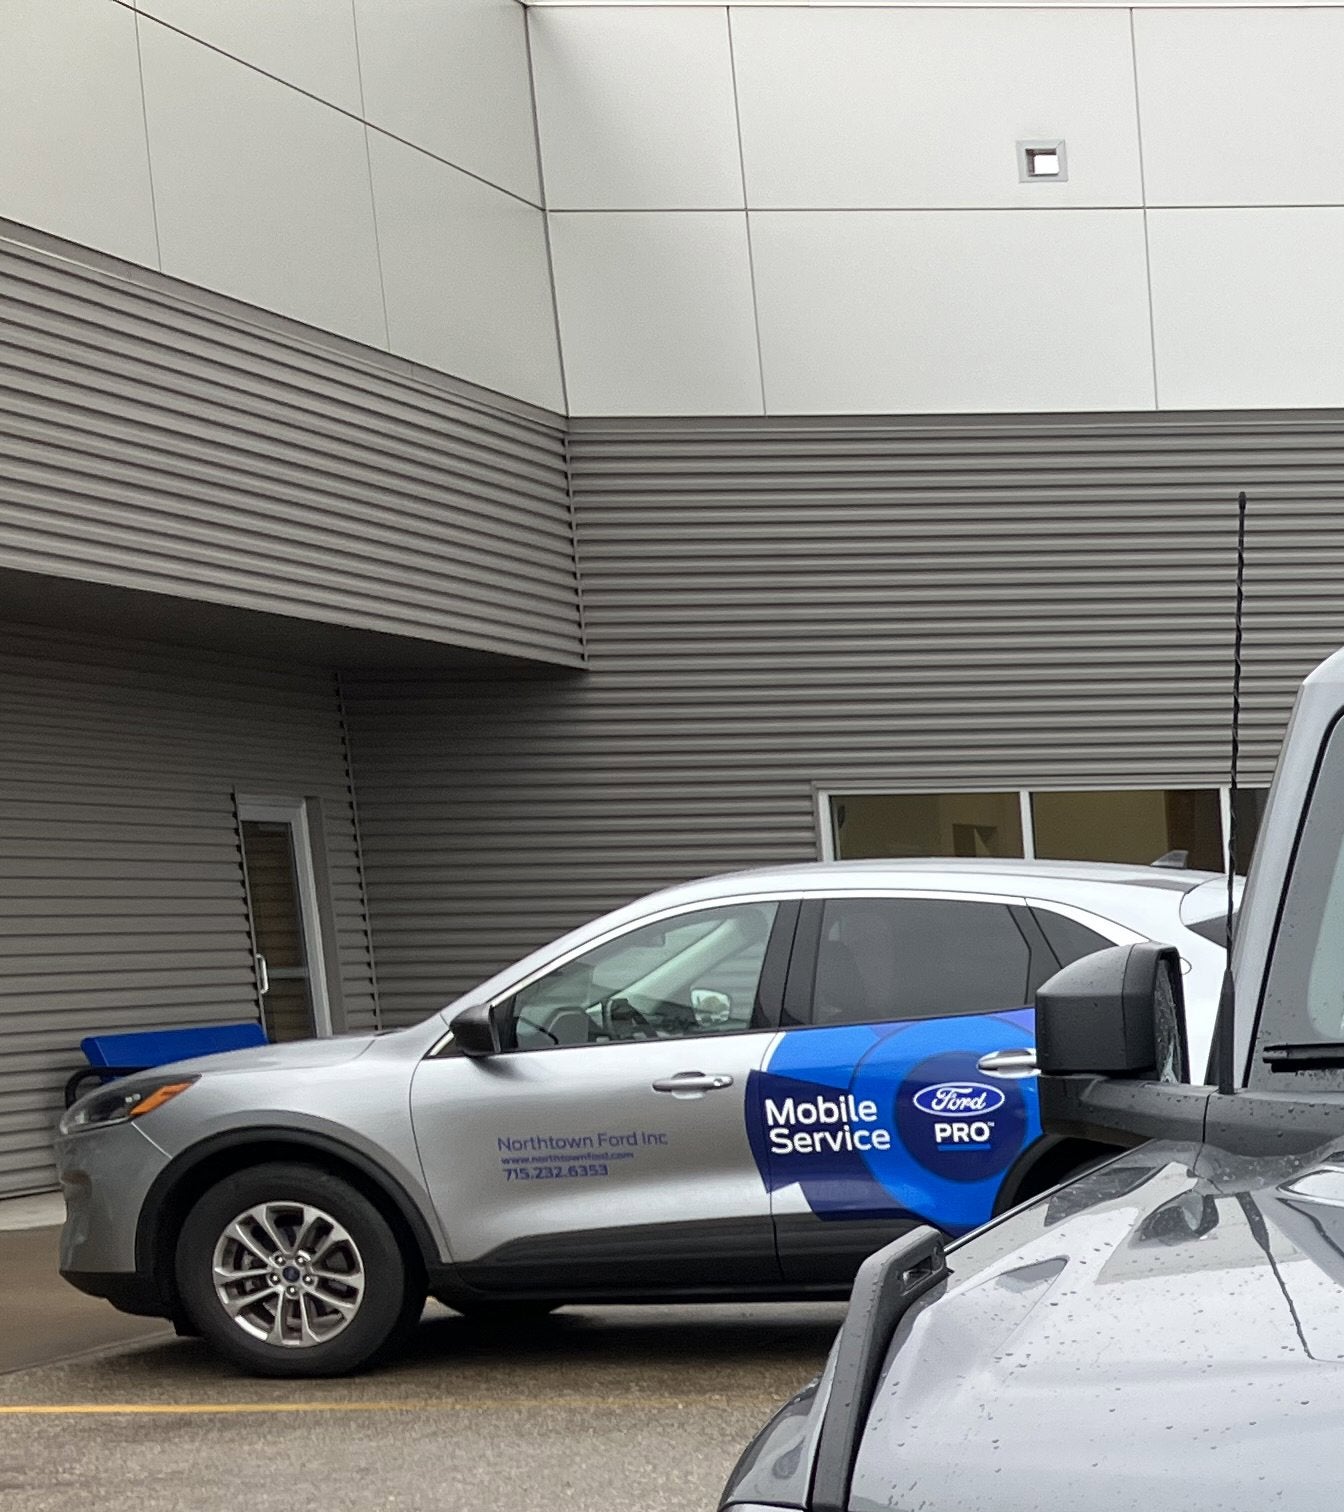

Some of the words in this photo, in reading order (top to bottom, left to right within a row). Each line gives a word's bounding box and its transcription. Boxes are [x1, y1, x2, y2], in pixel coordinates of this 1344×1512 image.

[764, 1094, 878, 1125] Mobile
[932, 1088, 987, 1111] Ford
[497, 1135, 594, 1152] Northtown
[599, 1131, 639, 1146] Ford
[642, 1131, 668, 1145] Inc
[769, 1125, 891, 1154] Service
[502, 1164, 609, 1181] 715.232.6353
